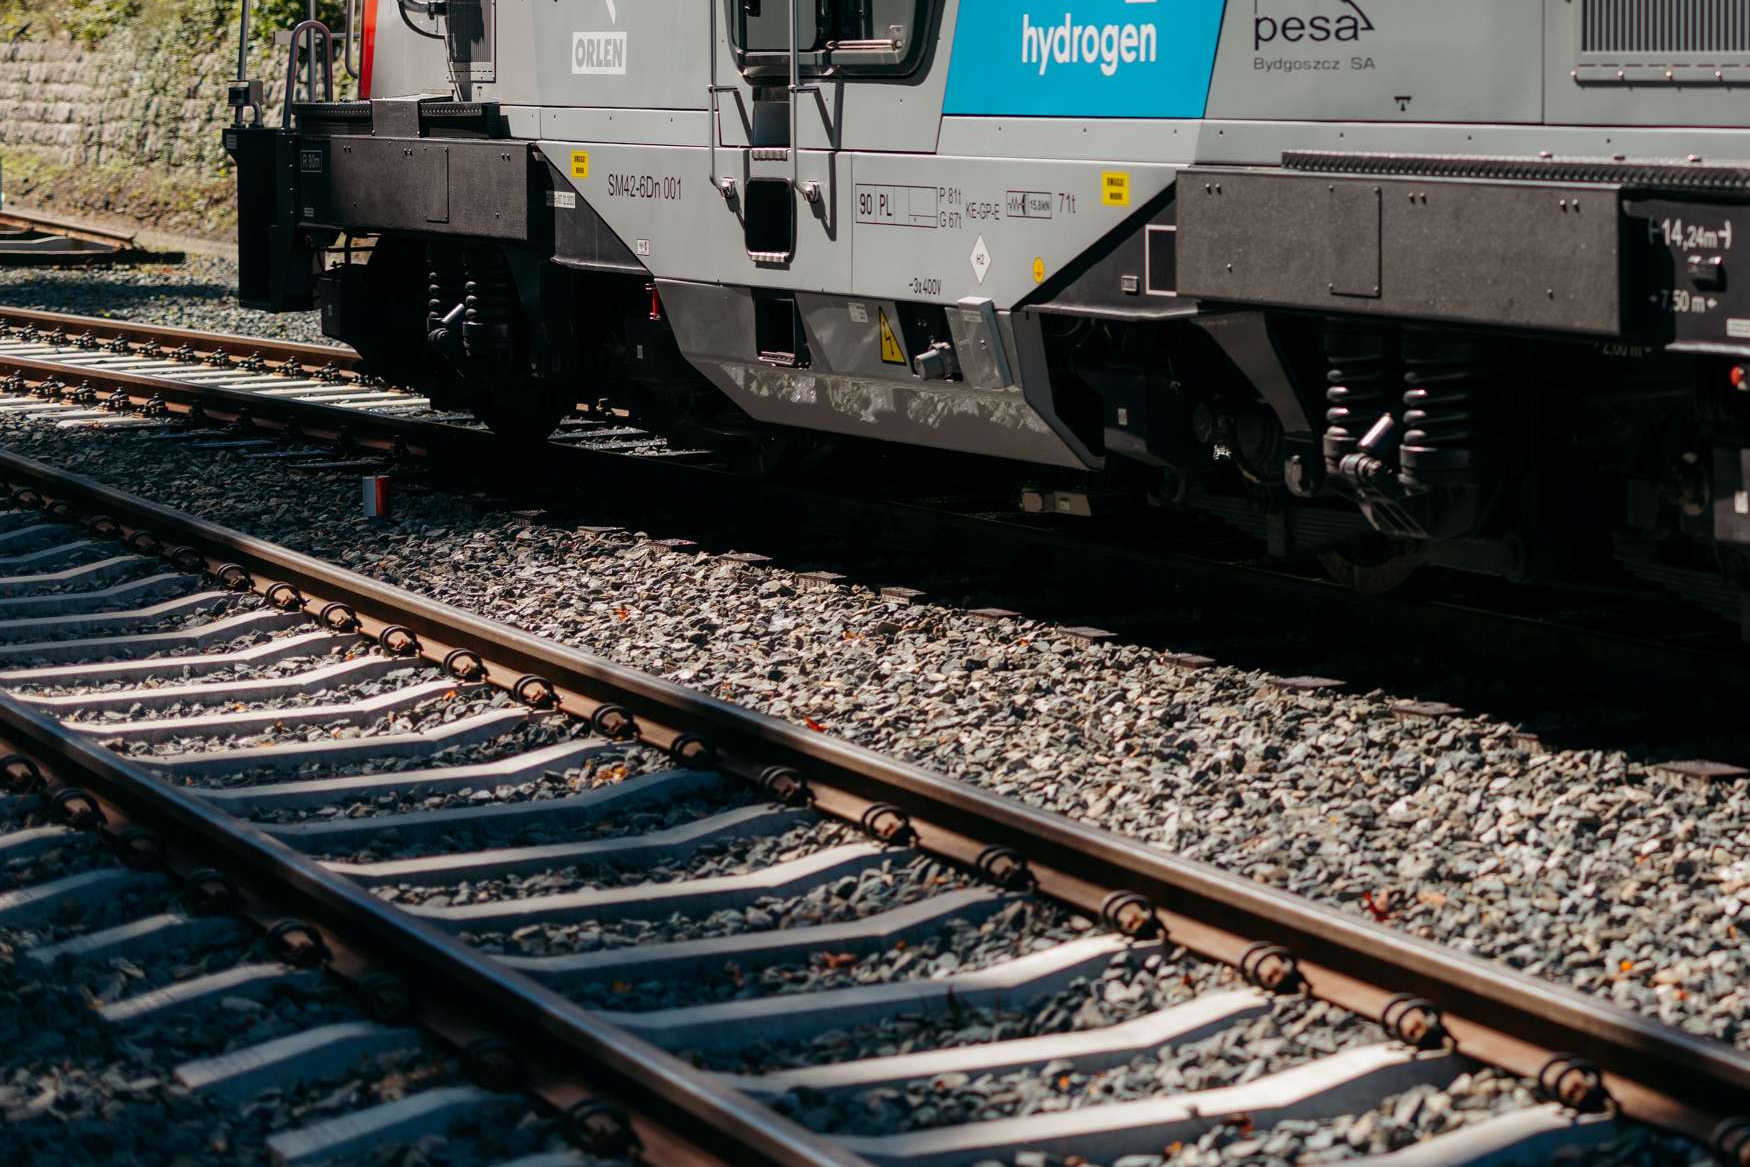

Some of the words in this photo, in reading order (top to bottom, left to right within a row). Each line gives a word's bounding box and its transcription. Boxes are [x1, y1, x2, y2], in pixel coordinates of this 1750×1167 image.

[1254, 14, 1360, 51] pesa
[575, 38, 624, 68] ORLEN
[1021, 12, 1158, 76] hydrogen
[1253, 57, 1341, 73] Bydgoszcz
[1350, 56, 1376, 71] SA
[608, 173, 661, 199] SM42-6Dn
[663, 177, 682, 200] 001
[859, 193, 873, 215] 90
[879, 194, 893, 216] PL
[1059, 192, 1076, 214] 71t
[940, 210, 947, 228] G
